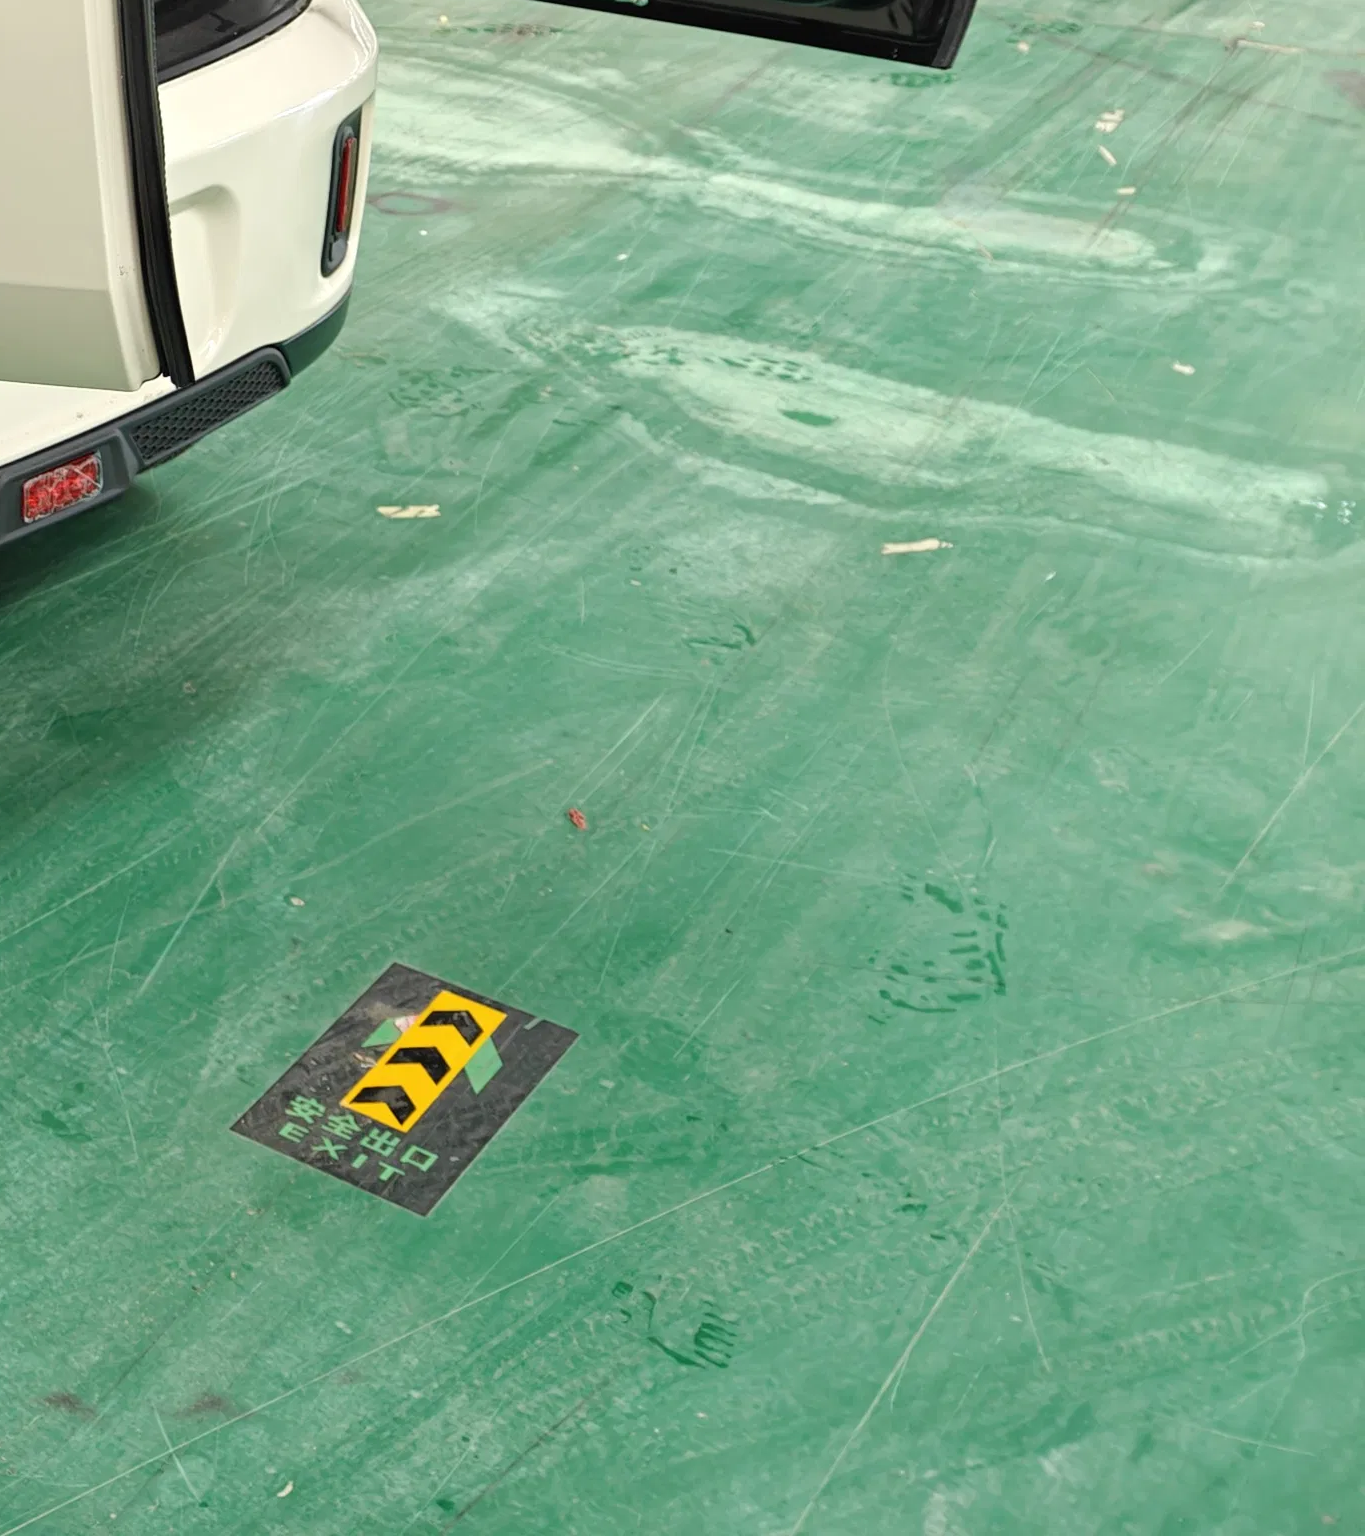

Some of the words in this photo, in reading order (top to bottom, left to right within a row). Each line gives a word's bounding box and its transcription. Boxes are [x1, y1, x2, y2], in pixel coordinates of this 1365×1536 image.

[277, 1121, 406, 1182] EXIT
[284, 1094, 439, 1172] 安全出口
